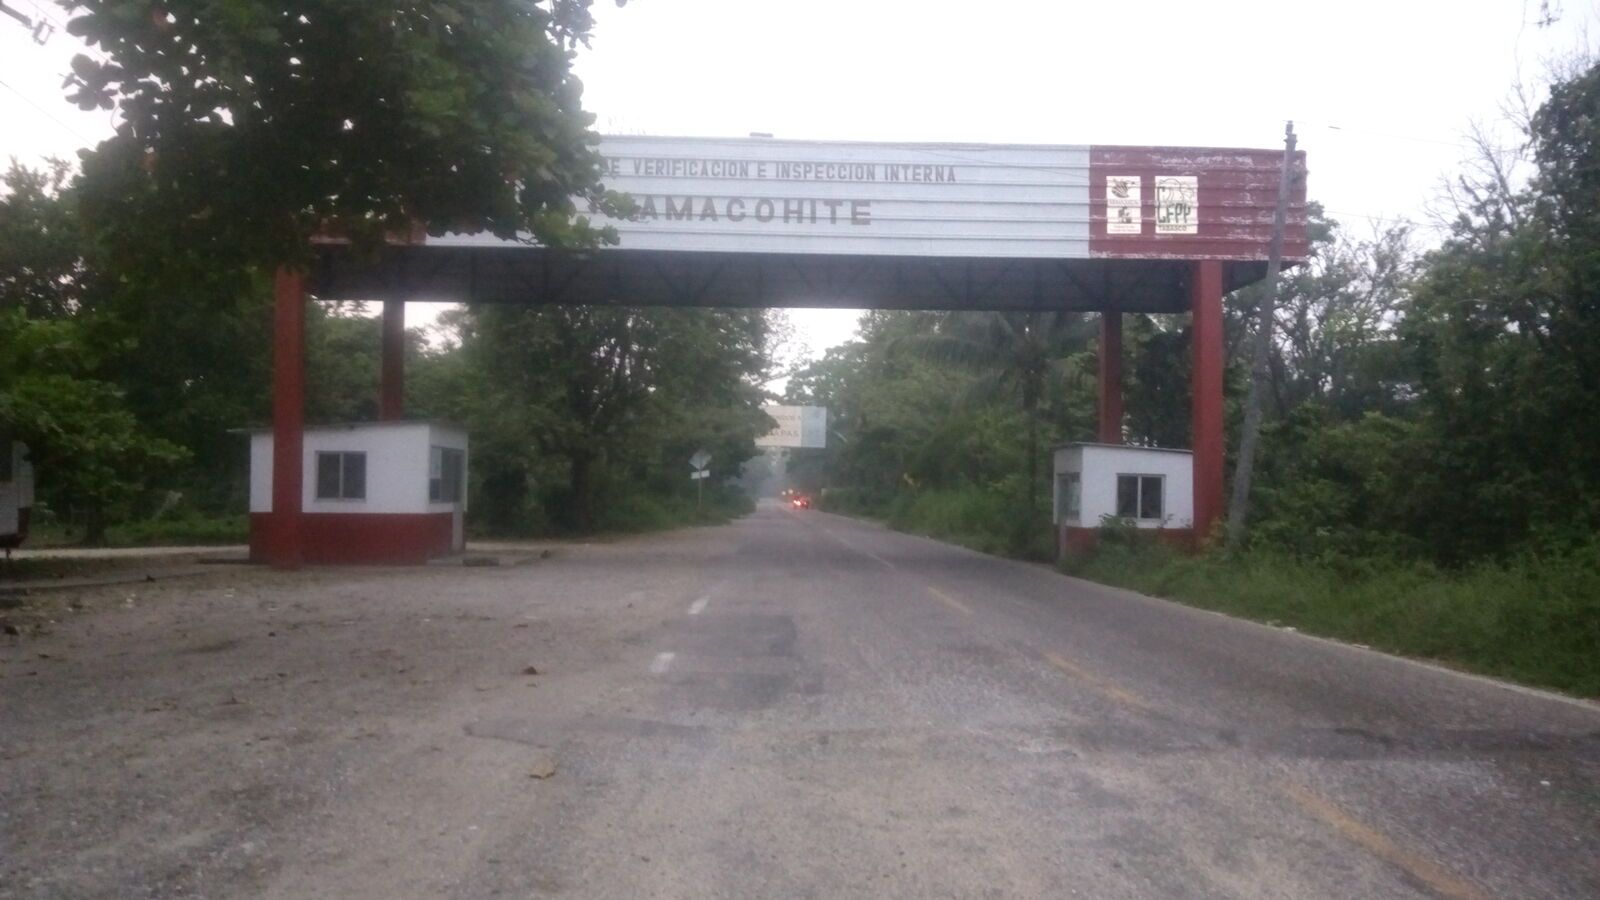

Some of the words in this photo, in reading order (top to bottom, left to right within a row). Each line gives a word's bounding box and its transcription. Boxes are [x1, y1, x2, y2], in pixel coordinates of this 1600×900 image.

[633, 158, 749, 178] VERIFICACION
[757, 161, 767, 178] E
[775, 161, 876, 181] INSPECCION
[885, 163, 956, 183] INTERNA
